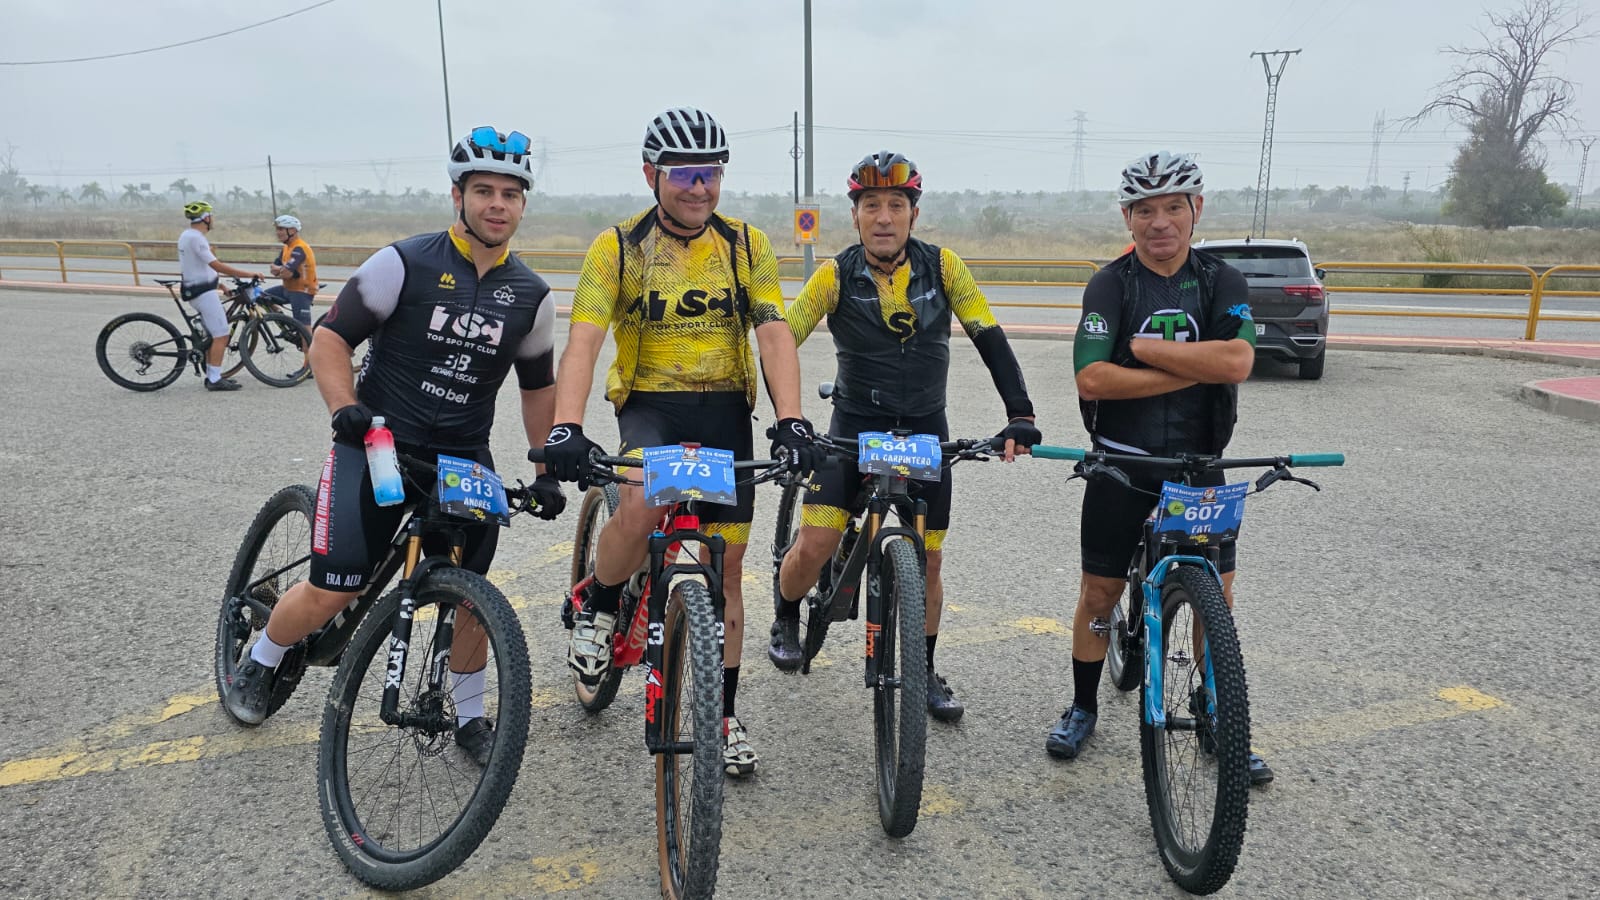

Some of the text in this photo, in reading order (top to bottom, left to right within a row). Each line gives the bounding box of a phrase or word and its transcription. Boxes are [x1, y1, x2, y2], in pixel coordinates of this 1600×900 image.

[674, 321, 706, 330] SPORT
[709, 320, 733, 328] CLUB
[426, 332, 444, 342] TOP
[477, 345, 497, 355] CLUB
[421, 381, 470, 404] mobel
[882, 441, 917, 453] 641
[870, 452, 880, 461] EL
[669, 461, 711, 477] 773
[461, 477, 493, 498] 613
[1184, 504, 1226, 521] 607
[326, 572, 362, 587] ERA ALTA
[385, 651, 405, 689] FOX
[328, 810, 360, 857] PIRELLI
